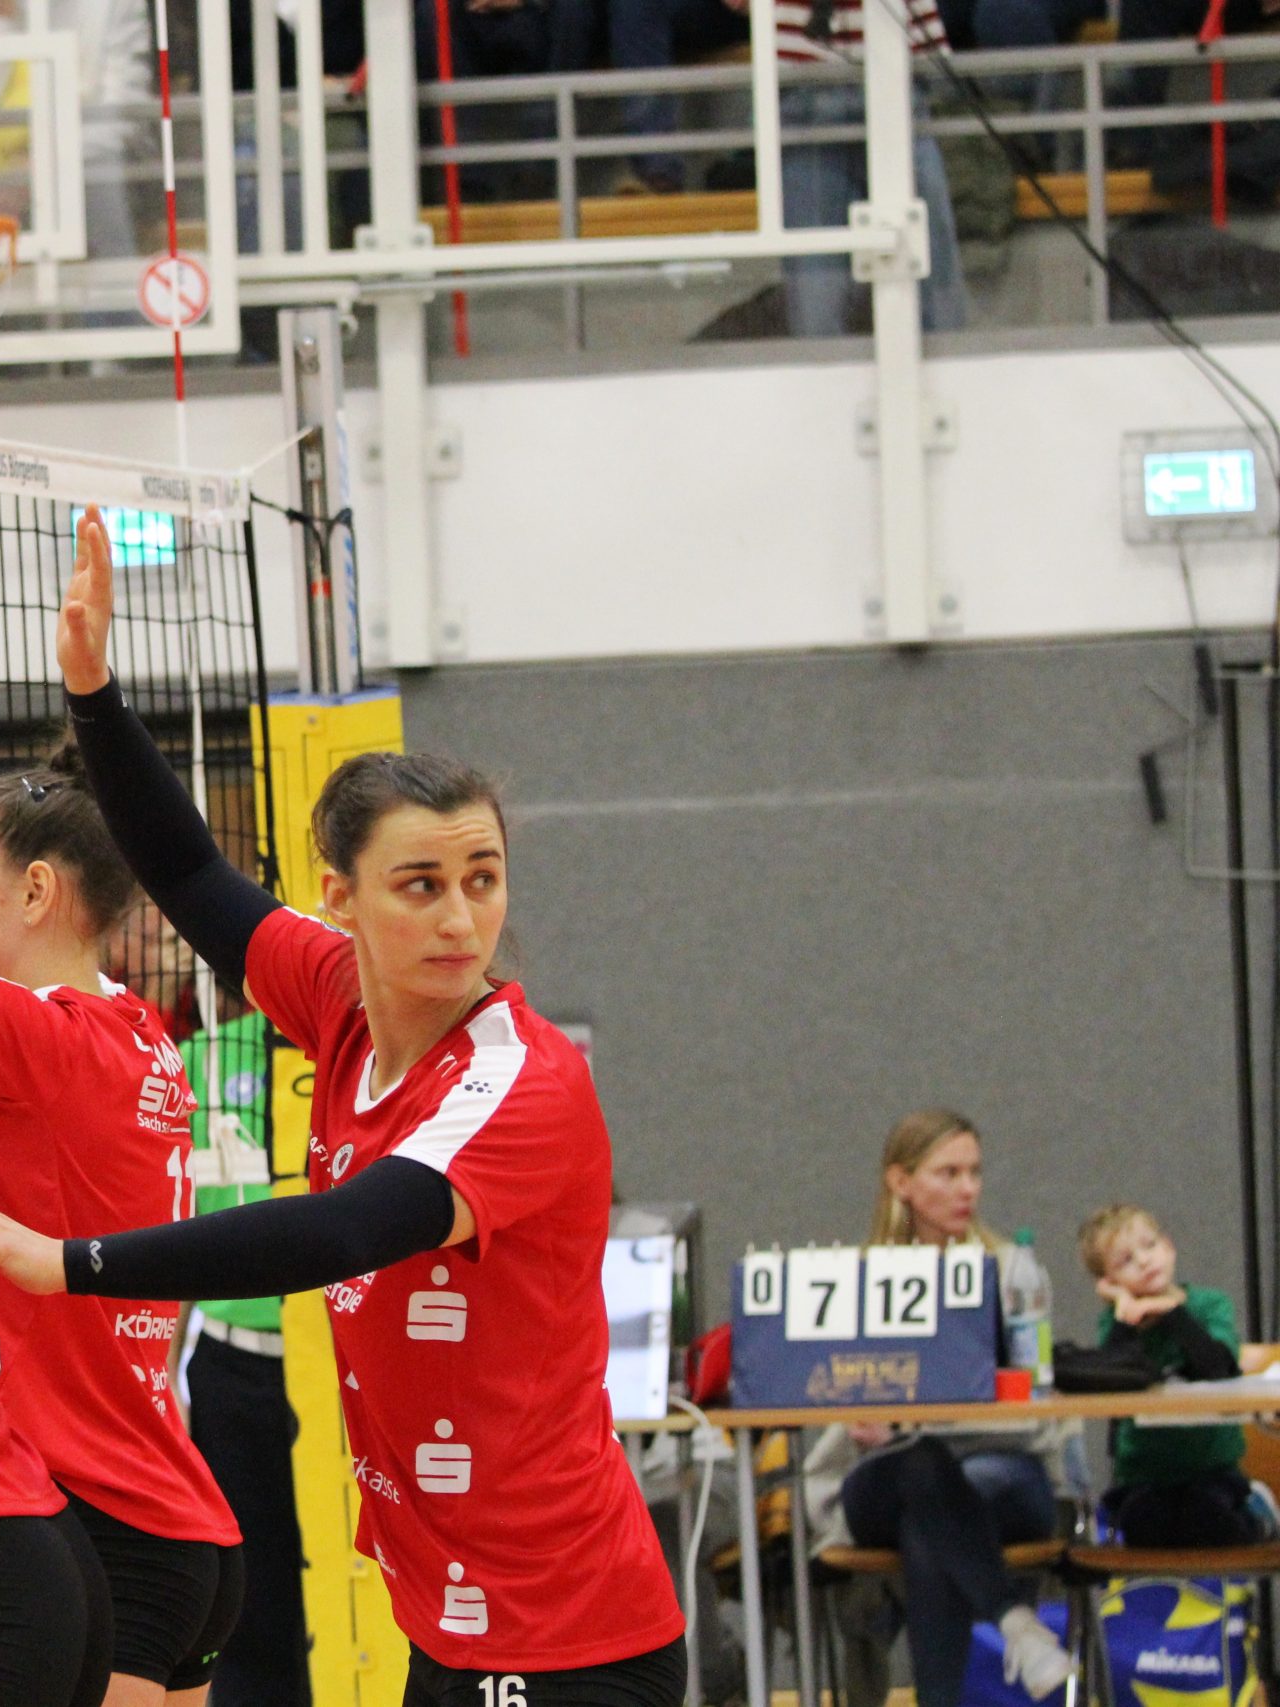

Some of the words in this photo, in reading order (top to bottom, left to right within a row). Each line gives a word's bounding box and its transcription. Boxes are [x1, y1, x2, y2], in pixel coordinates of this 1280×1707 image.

[752, 1267, 773, 1306] 0
[952, 1261, 973, 1300] 0
[809, 1280, 837, 1329] 7
[876, 1277, 928, 1326] 12
[478, 1674, 528, 1707] 16
